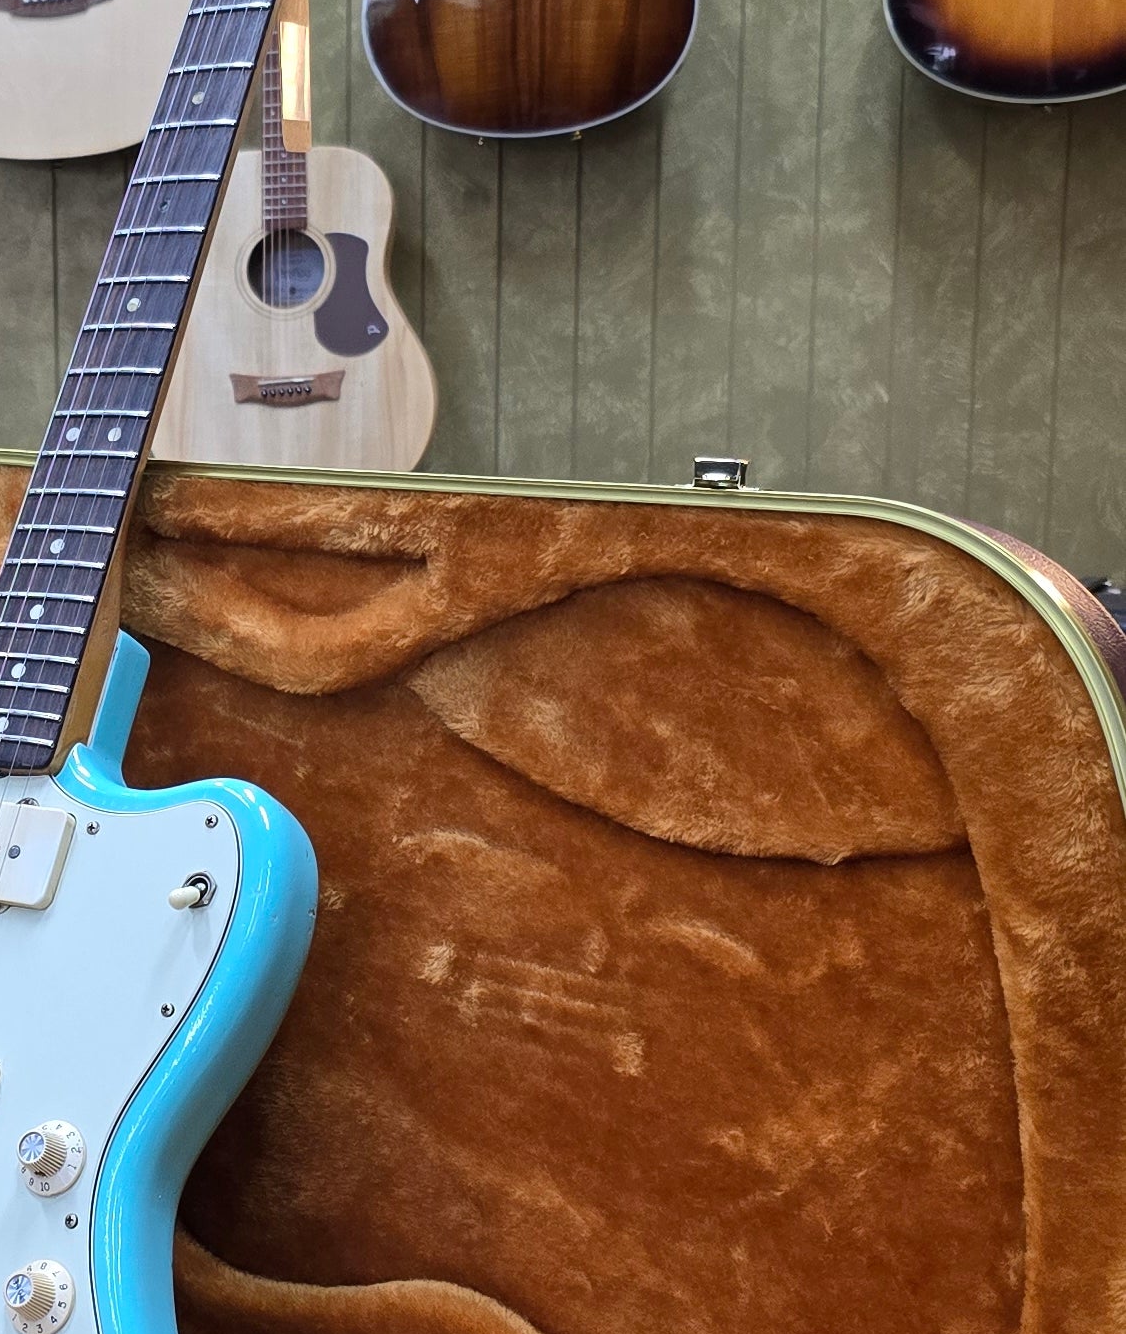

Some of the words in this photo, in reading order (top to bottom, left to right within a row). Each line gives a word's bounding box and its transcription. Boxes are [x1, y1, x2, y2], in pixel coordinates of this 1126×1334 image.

[66, 1131, 76, 1139] 3
[40, 1181, 51, 1192] 10
[22, 1323, 28, 1333] 2
[36, 1323, 43, 1334] 3
[50, 1315, 58, 1323] 4
[57, 1300, 67, 1309] 5
